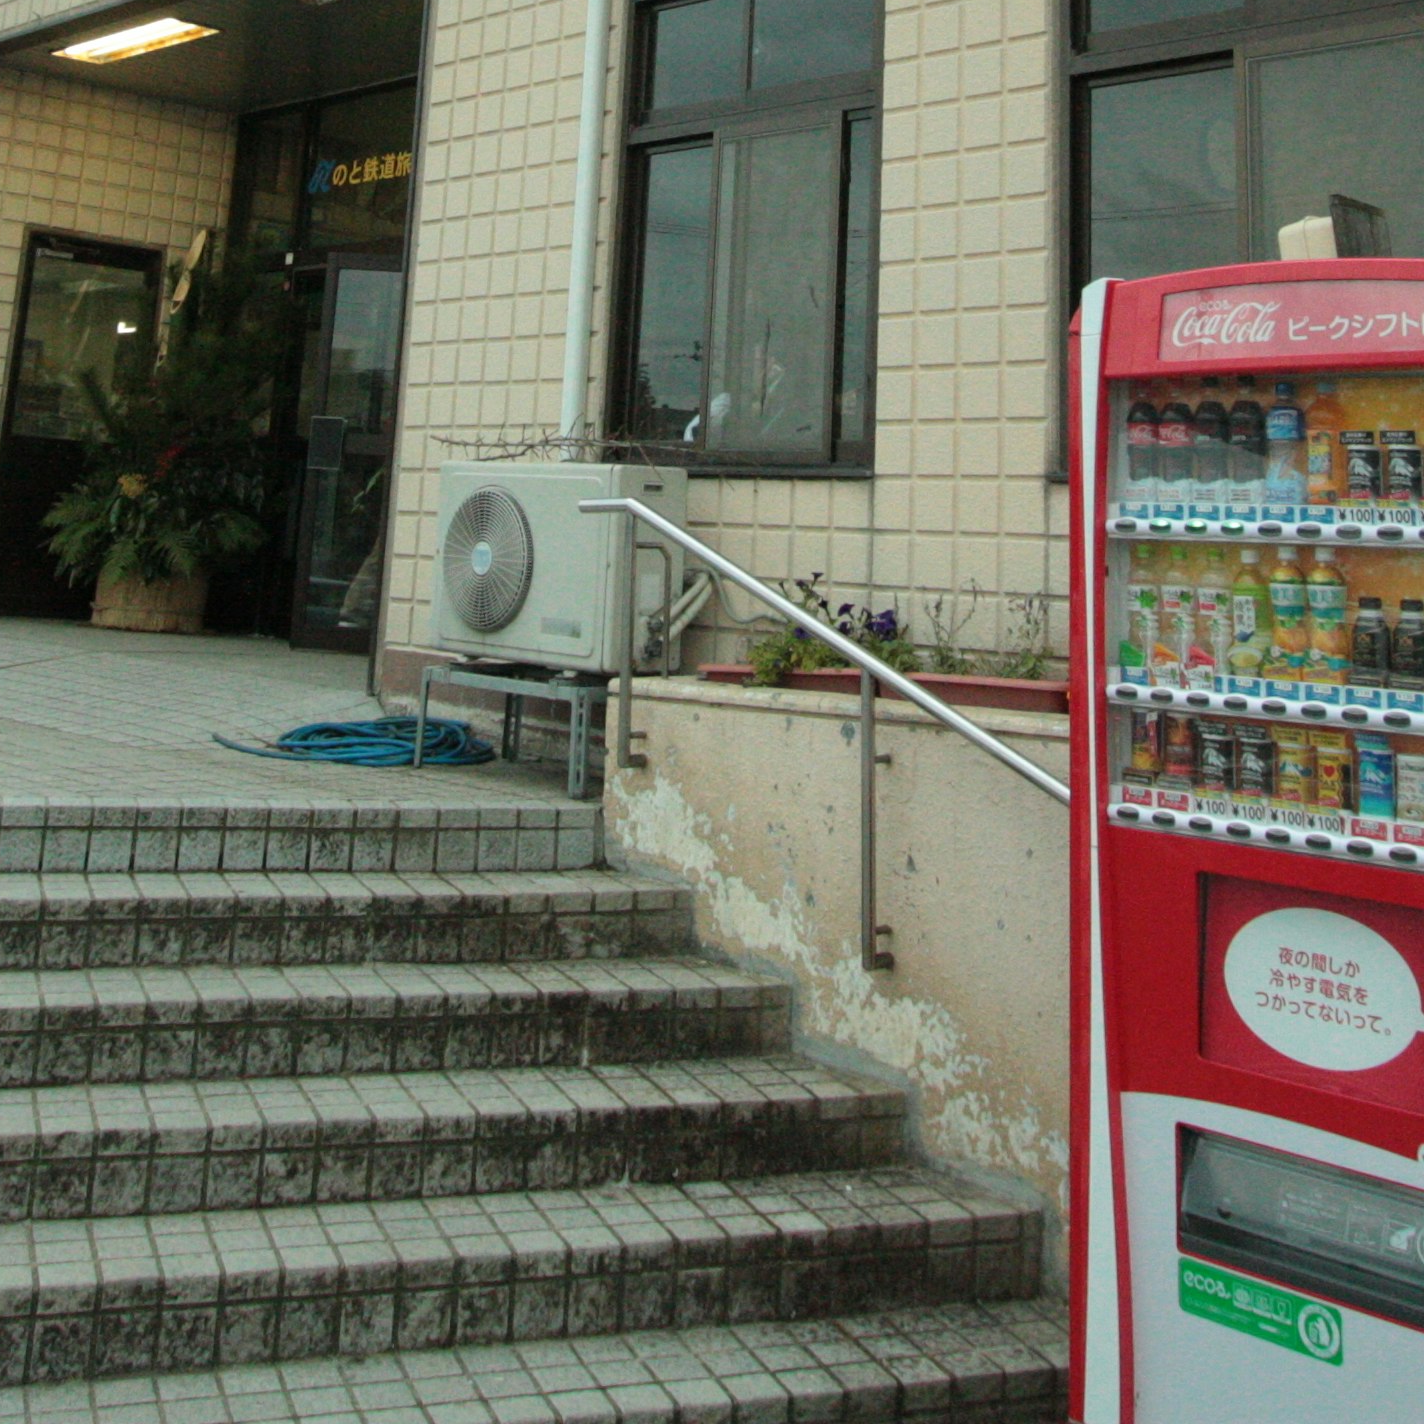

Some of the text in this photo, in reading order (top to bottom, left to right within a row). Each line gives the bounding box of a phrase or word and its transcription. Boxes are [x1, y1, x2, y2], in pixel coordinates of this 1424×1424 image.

[1171, 300, 1282, 348] Coca-Cola
[1338, 508, 1371, 522] ¥100
[1378, 509, 1412, 524] ¥100
[1195, 798, 1225, 815] ¥100
[1231, 803, 1263, 821] ¥100
[1269, 808, 1303, 826] ¥100
[1306, 813, 1340, 832] ¥100
[1278, 946, 1361, 979] 夜の間しか
[1268, 967, 1369, 1007] 冷やす電気を
[1254, 991, 1392, 1037] つかってないって。
